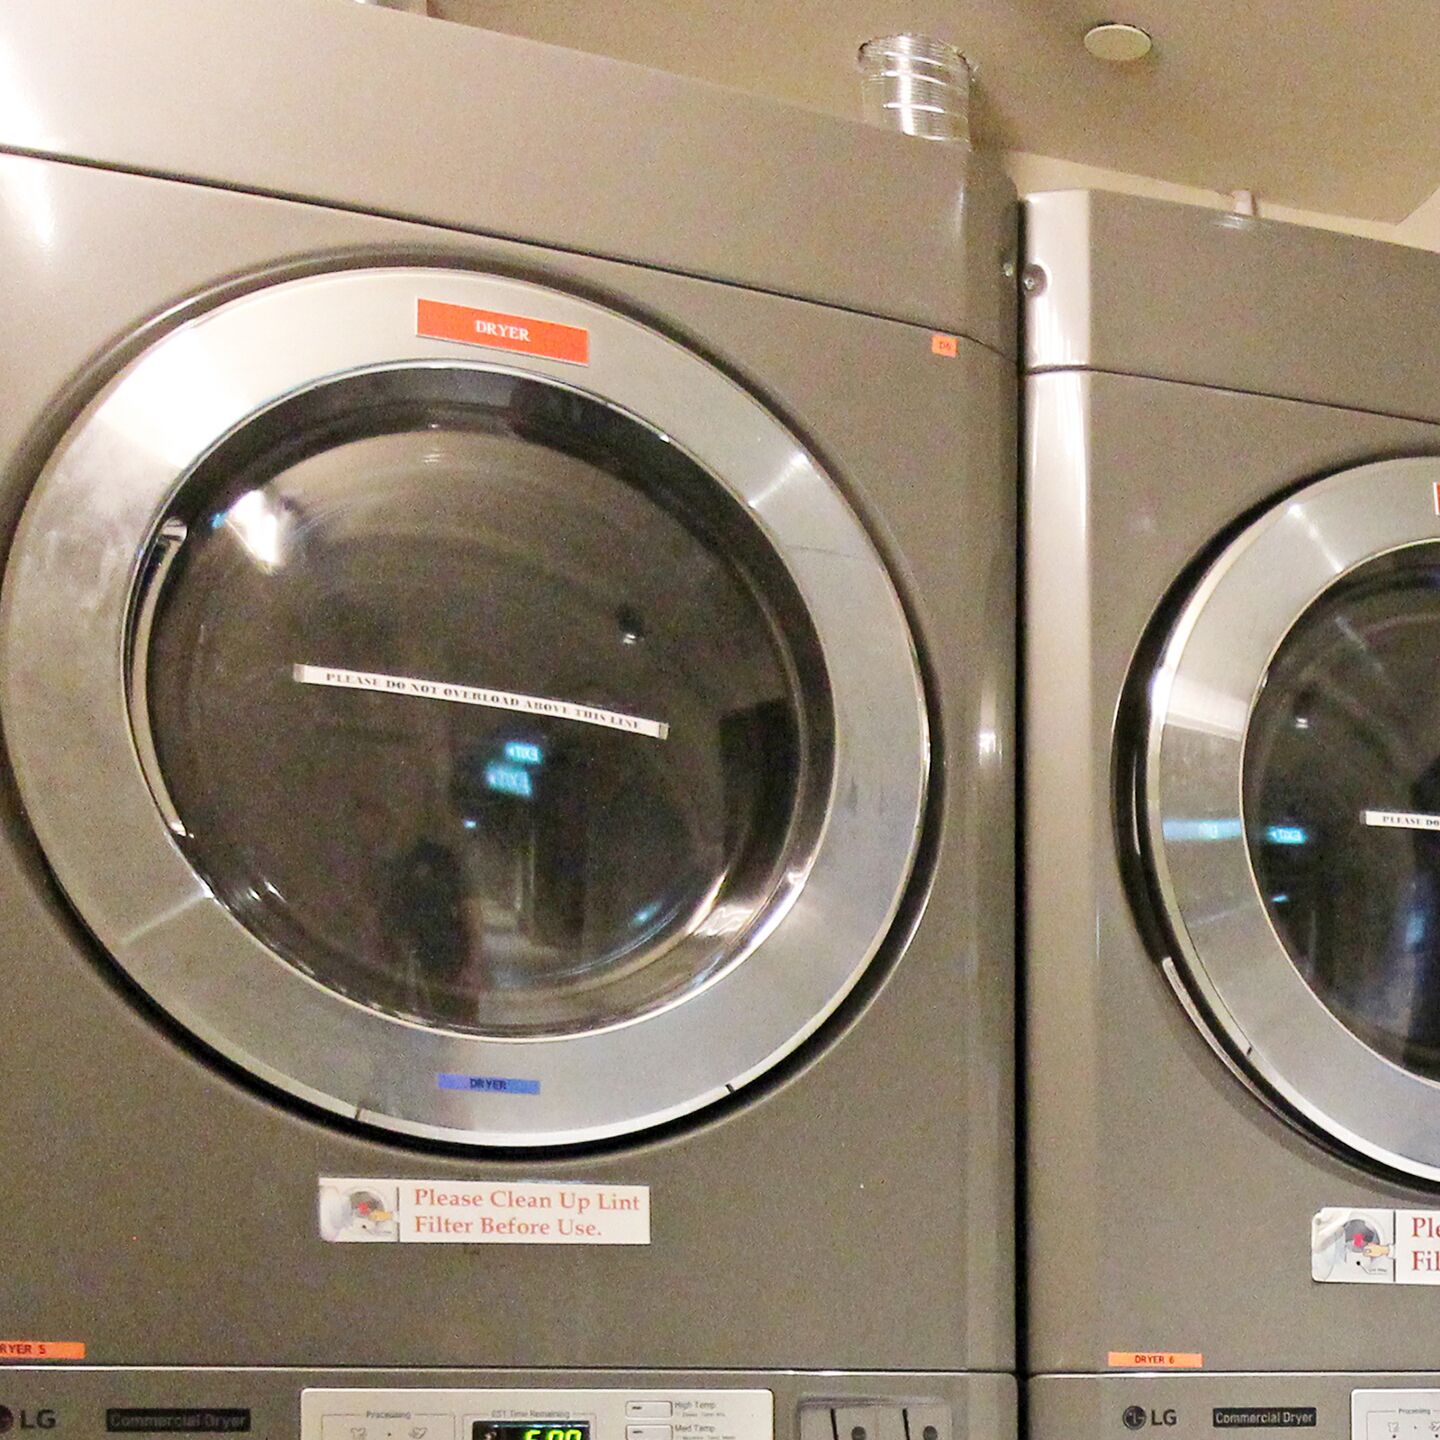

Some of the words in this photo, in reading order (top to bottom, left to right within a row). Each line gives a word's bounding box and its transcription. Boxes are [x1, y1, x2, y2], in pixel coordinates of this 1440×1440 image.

[475, 319, 530, 342] DRYER
[326, 673, 378, 687] PLEASE
[386, 680, 405, 690] DO
[412, 683, 437, 695] NOT
[444, 689, 519, 707] OVERLOAD
[525, 700, 568, 715] ABOVE
[575, 709, 605, 722] THIS
[610, 715, 640, 729] LINE
[1382, 815, 1421, 826] PLEASE
[1426, 819, 1440, 827] DO
[469, 1078, 507, 1091] DRYER
[414, 1188, 483, 1208] Please
[490, 1189, 551, 1209] Clean
[559, 1192, 591, 1211] Up
[598, 1193, 640, 1211] Lint
[415, 1216, 473, 1234] Filter
[480, 1216, 551, 1236] Before
[558, 1218, 602, 1237] Use.
[1134, 1355, 1165, 1364] DRYER
[1169, 1356, 1175, 1364] 6
[20, 1409, 57, 1430] LG
[1150, 1409, 1177, 1427] LG
[1215, 1411, 1281, 1425] Commercial
[1282, 1411, 1314, 1426] Dryer
